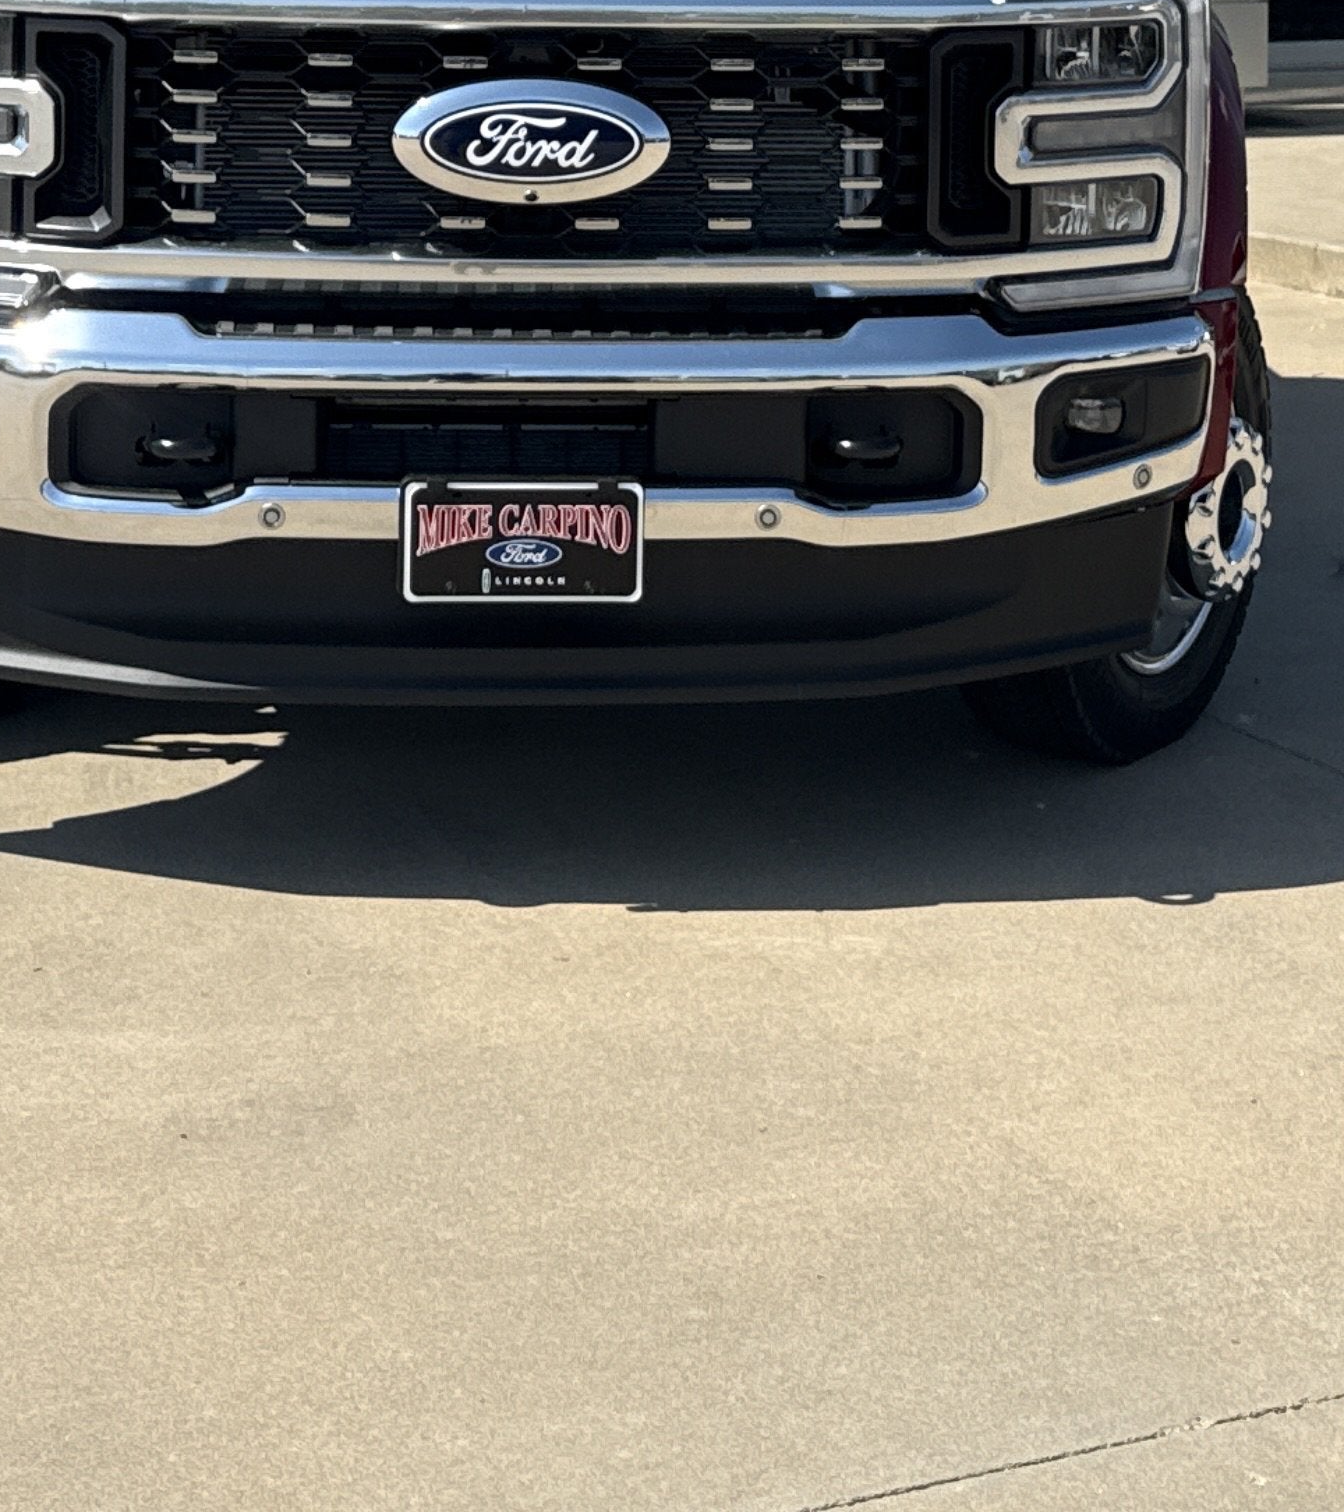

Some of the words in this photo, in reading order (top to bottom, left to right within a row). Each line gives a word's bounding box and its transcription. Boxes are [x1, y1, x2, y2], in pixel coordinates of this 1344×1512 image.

[466, 114, 599, 168] Ford
[416, 504, 493, 557] MIKE
[498, 503, 632, 555] CARPINO
[500, 543, 547, 564] Ford
[494, 576, 567, 586] LINCOLN
